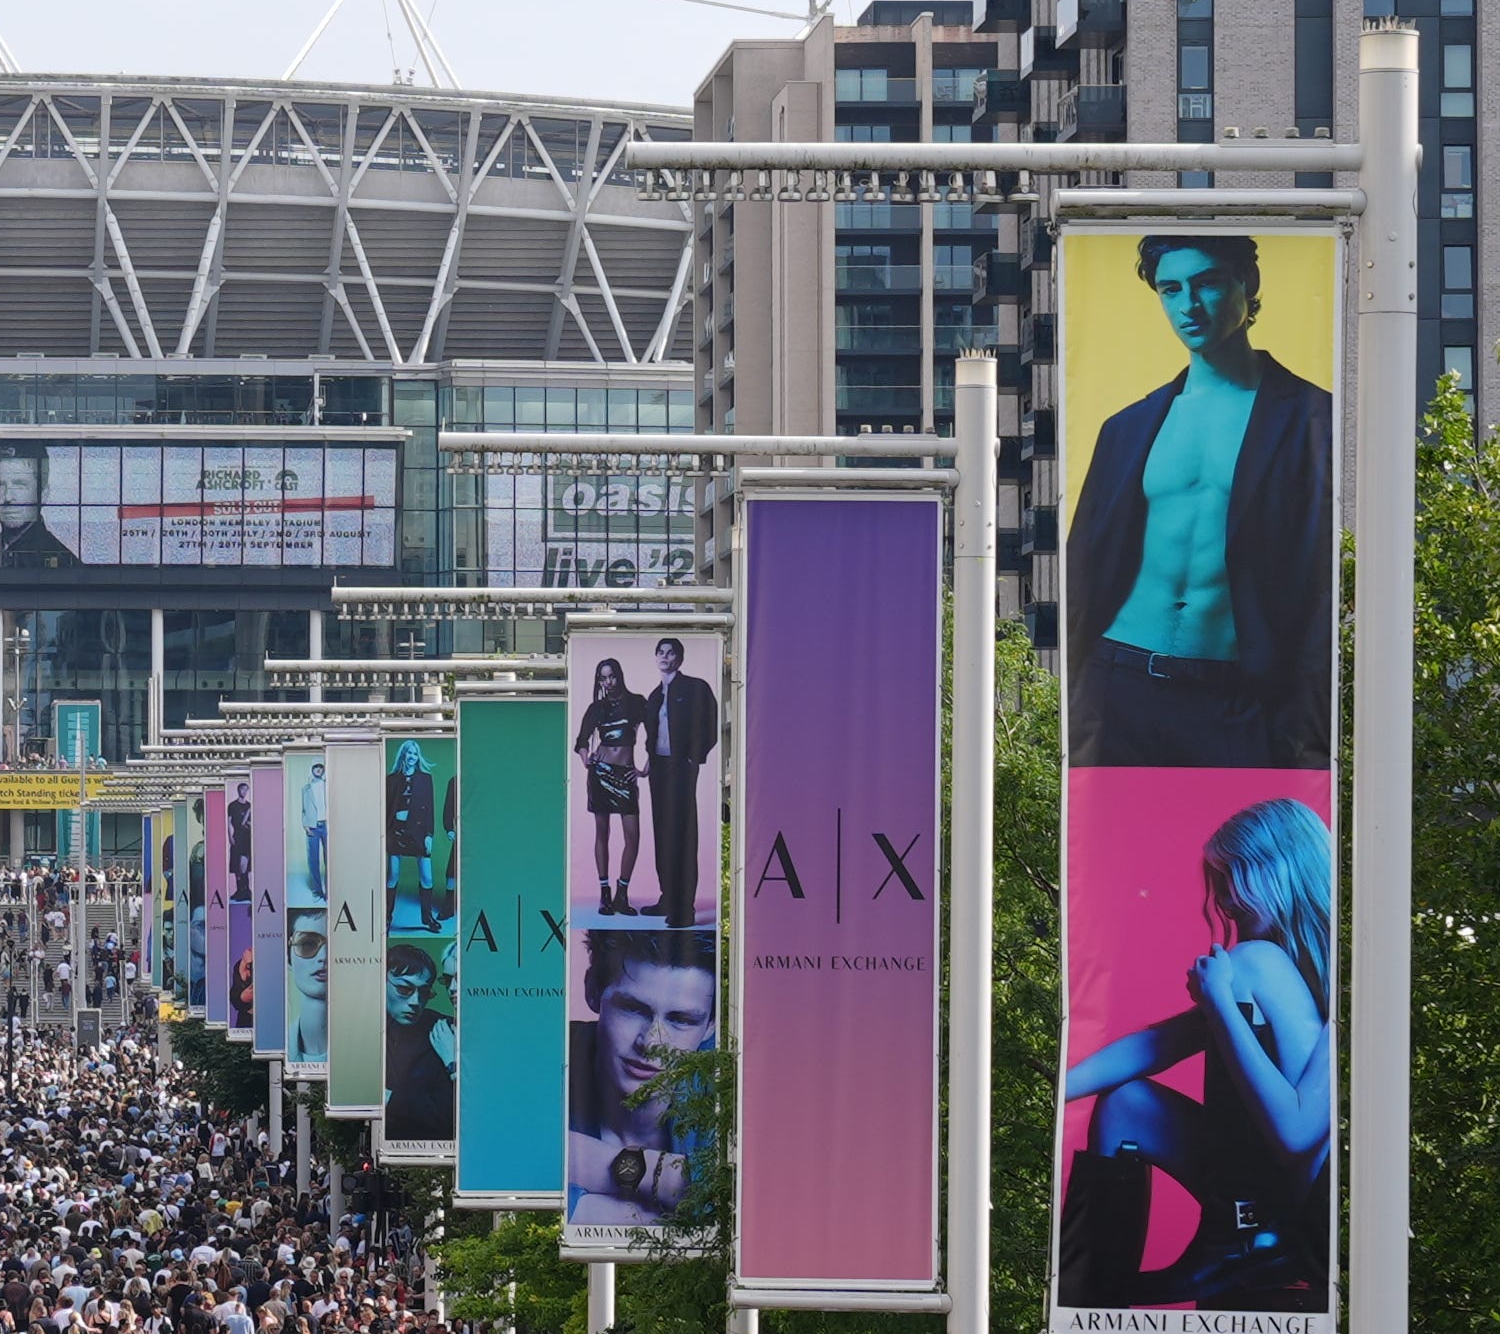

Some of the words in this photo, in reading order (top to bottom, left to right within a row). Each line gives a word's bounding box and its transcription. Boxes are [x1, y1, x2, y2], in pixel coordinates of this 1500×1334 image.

[203, 469, 261, 480] RICHARD
[196, 479, 265, 491] ASHCROFT
[213, 501, 247, 516] SOLD
[253, 499, 281, 514] OUT
[171, 519, 216, 527] LONDON
[219, 519, 271, 527] WEMBLEY
[275, 519, 321, 527] STADIUM
[330, 530, 372, 538] AUGUST
[250, 541, 313, 549] SEPTEMBER
[541, 547, 636, 587] live
[36, 776, 46, 785] to
[48, 775, 59, 785] all
[17, 788, 56, 800] Standing
[58, 788, 88, 798] tickes
[334, 957, 366, 965] ARMANI
[753, 955, 822, 970] ARMANI
[831, 956, 926, 971] EXCHANGE
[466, 987, 510, 998] ARMANI
[390, 1142, 427, 1150] ARMANI
[1069, 1312, 1167, 1332] ARMANI
